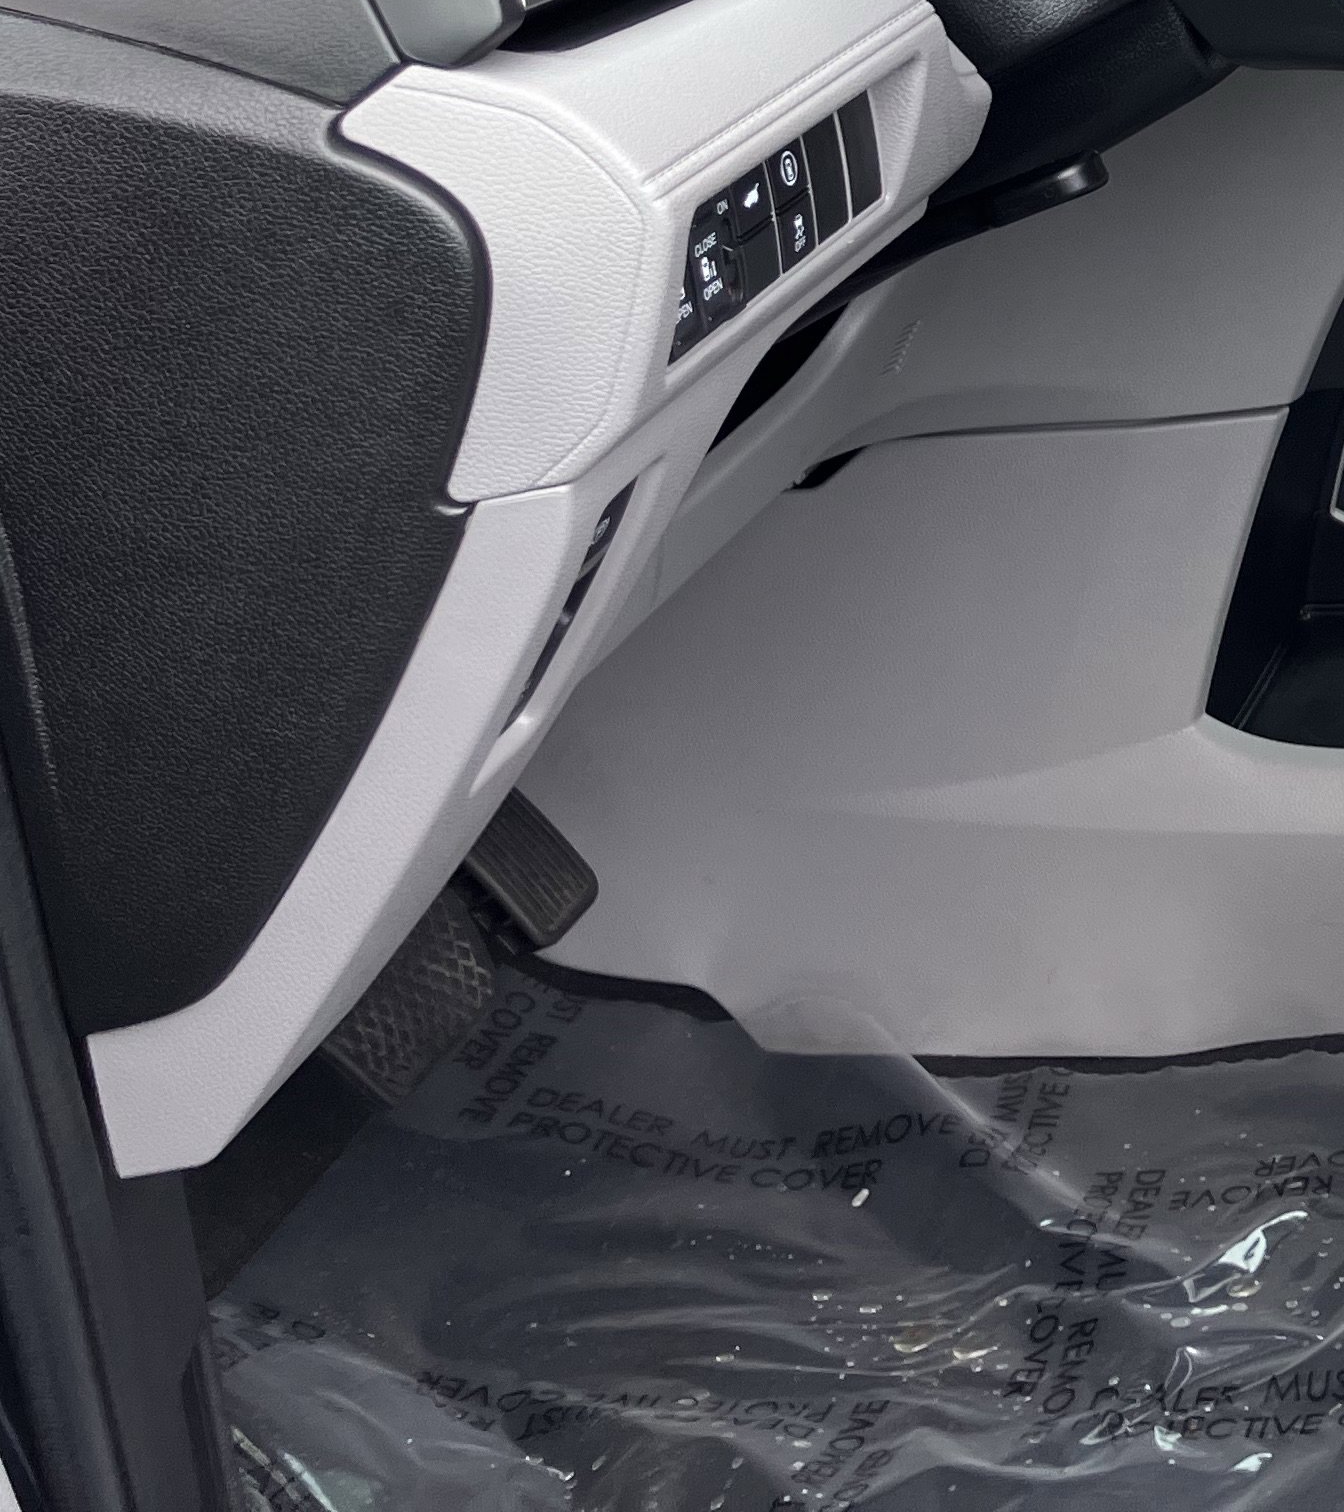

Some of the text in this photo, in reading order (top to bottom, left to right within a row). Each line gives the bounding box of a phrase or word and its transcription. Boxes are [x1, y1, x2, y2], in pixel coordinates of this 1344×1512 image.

[716, 199, 729, 215] ON
[694, 232, 717, 258] CLOSE
[794, 235, 807, 253] OFF
[703, 277, 723, 301] OPEN
[679, 301, 693, 321] PEN
[527, 1087, 675, 1137] DEALER
[691, 1128, 797, 1161] MUST
[811, 1111, 964, 1160] REMOVE
[506, 1110, 884, 1191] PROTECTIVE COVER
[1167, 1174, 1334, 1212] REMOVE
